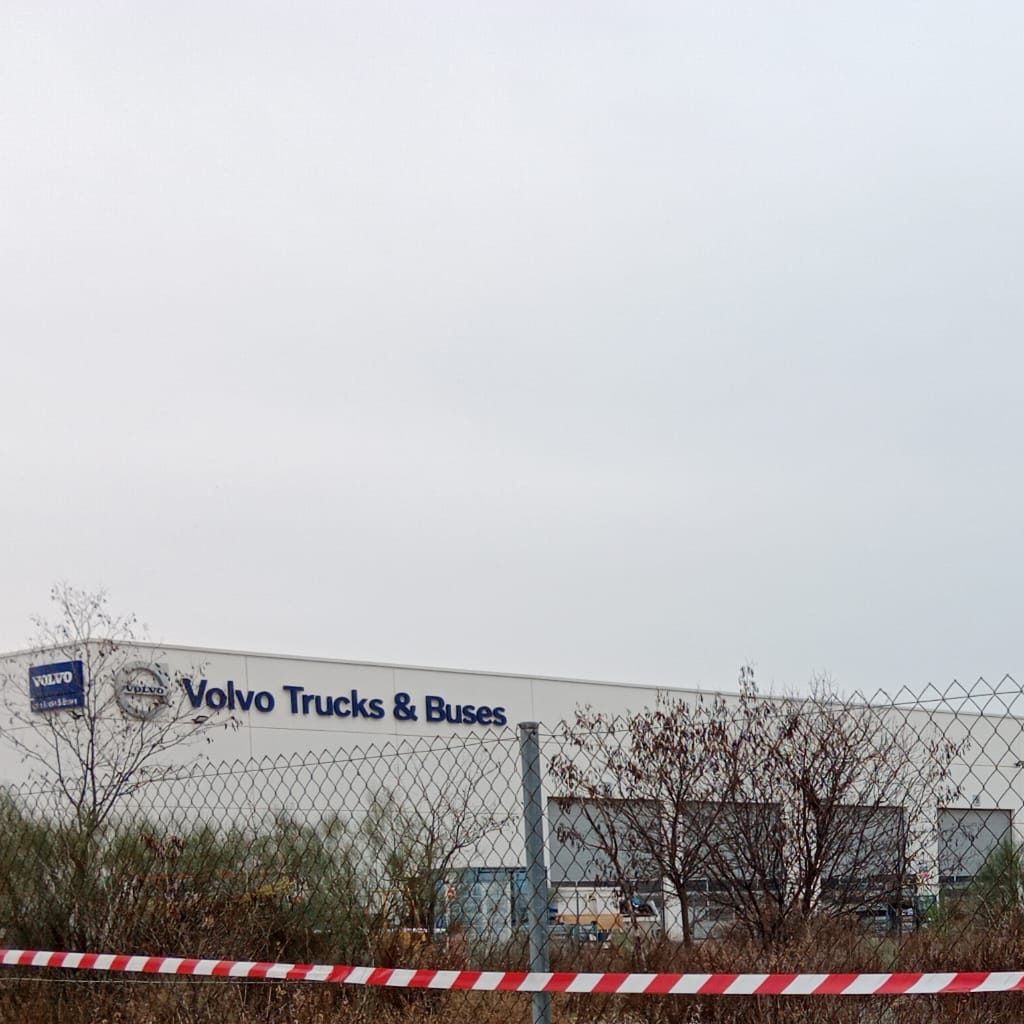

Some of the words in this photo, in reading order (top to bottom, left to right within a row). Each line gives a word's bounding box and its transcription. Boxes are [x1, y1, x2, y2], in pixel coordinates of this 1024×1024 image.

[31, 671, 73, 687] VOLVO
[183, 678, 275, 713] Volvo
[283, 685, 385, 720] Trucks
[393, 692, 418, 721] &
[426, 695, 507, 726] Buses
